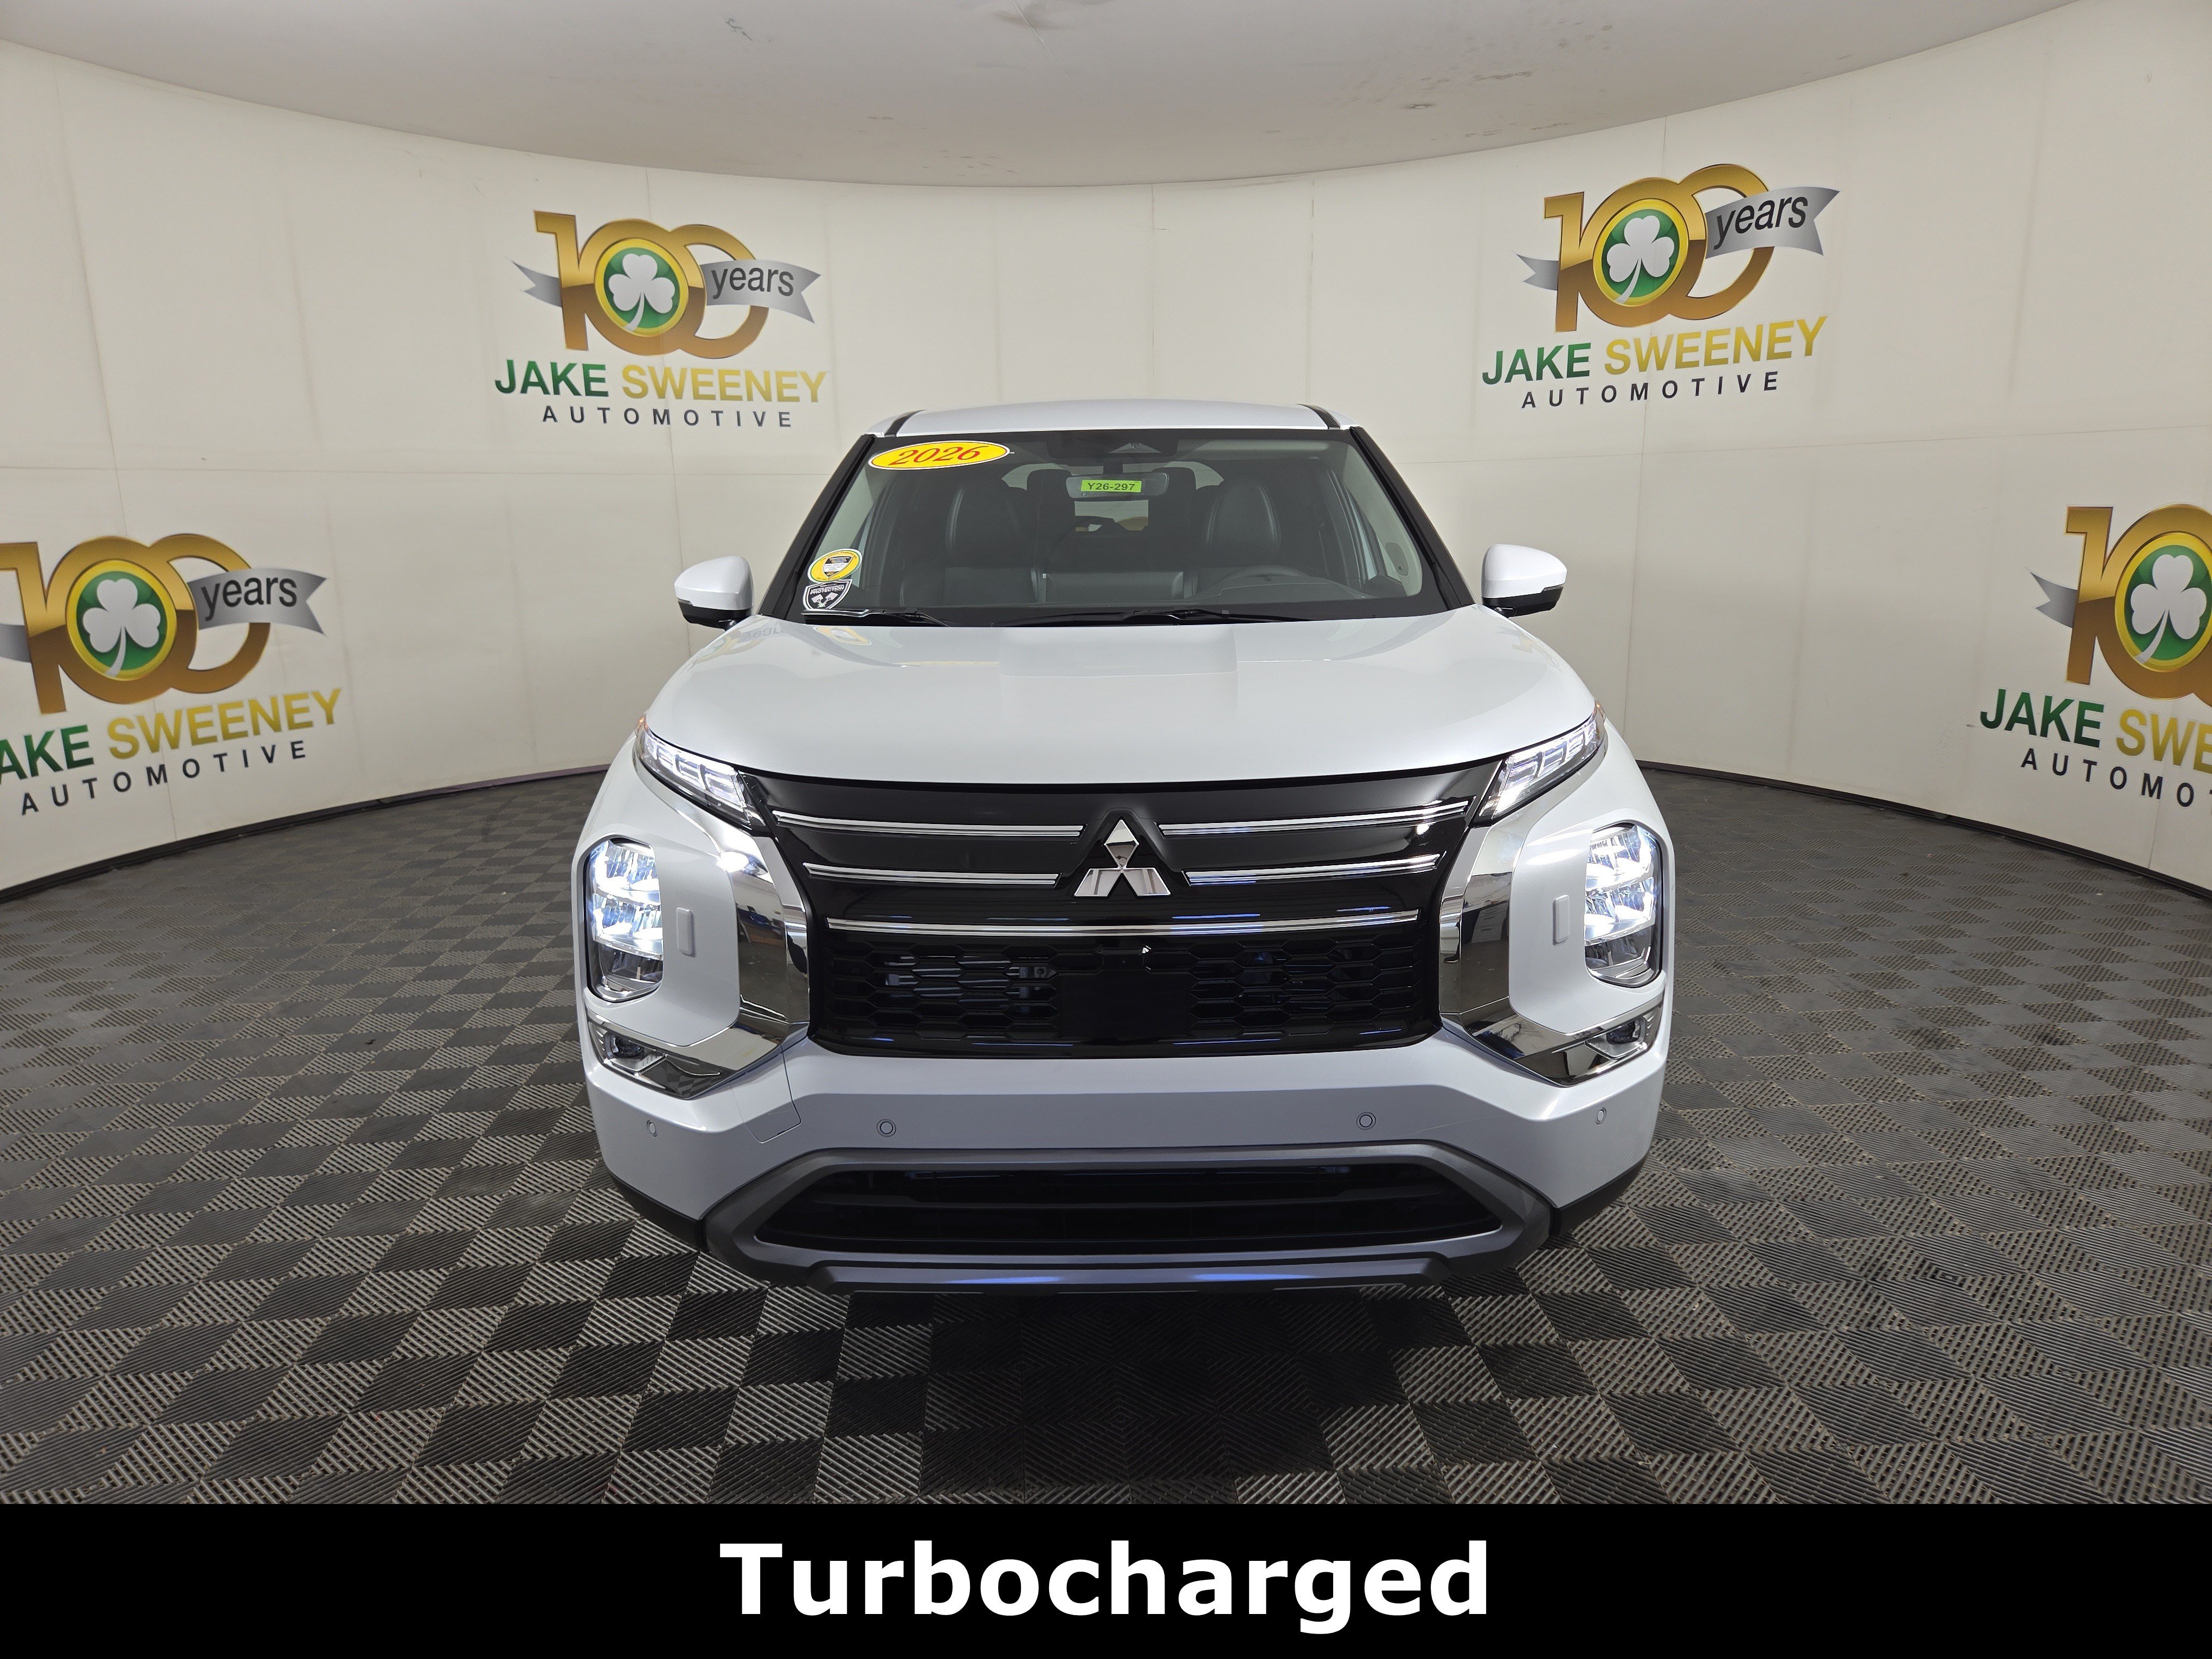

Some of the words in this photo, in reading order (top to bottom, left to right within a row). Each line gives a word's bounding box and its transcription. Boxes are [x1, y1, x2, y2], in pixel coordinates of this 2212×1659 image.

[1544, 163, 1774, 332] 100
[1713, 196, 1809, 250] years
[533, 210, 769, 359] 100
[711, 267, 795, 300] years
[1482, 343, 1592, 385] JAKE
[1604, 316, 1828, 375] SWEENEY
[495, 359, 609, 397] JAKE
[622, 365, 827, 403] SWEENEY
[1521, 371, 1778, 409] AUTOMOTIVE
[543, 406, 791, 427] AUTOMOTIVE
[888, 446, 989, 466] 2026
[1087, 483, 1136, 491] Y26-297
[201, 577, 297, 622] years
[107, 689, 342, 760] SWEENEY
[1980, 689, 2105, 748] JAKE
[22, 740, 306, 815] AUTOMOTIVE
[2021, 748, 2212, 807] AUTOMO
